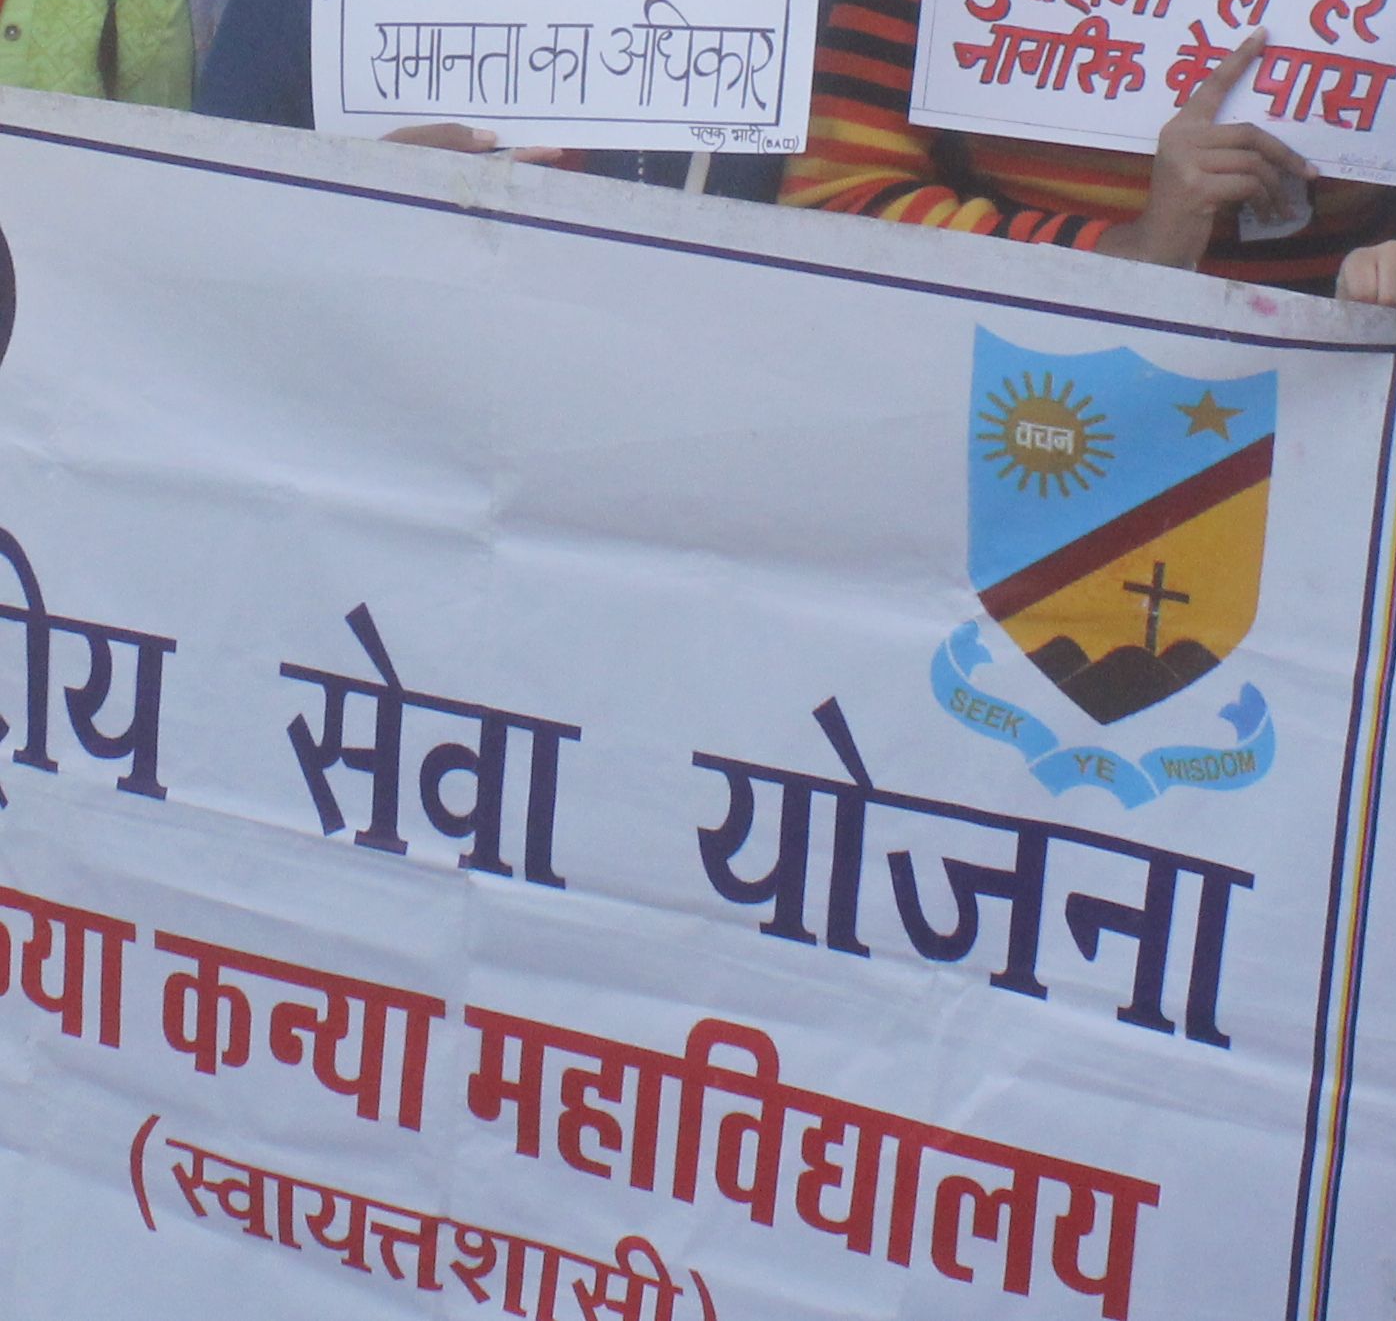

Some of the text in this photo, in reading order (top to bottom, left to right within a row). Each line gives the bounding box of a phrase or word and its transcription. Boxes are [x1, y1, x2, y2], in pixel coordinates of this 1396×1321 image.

[371, 23, 528, 104] समानता
[528, 23, 594, 105] का
[953, 15, 1146, 100] नागरिक
[1015, 421, 1076, 456] वचन
[949, 687, 1257, 784] SEEK YE WISDOM
[280, 602, 1255, 1050] सेवा योजना
[0, 885, 1161, 1321] या कन्या महाविद्यालय
